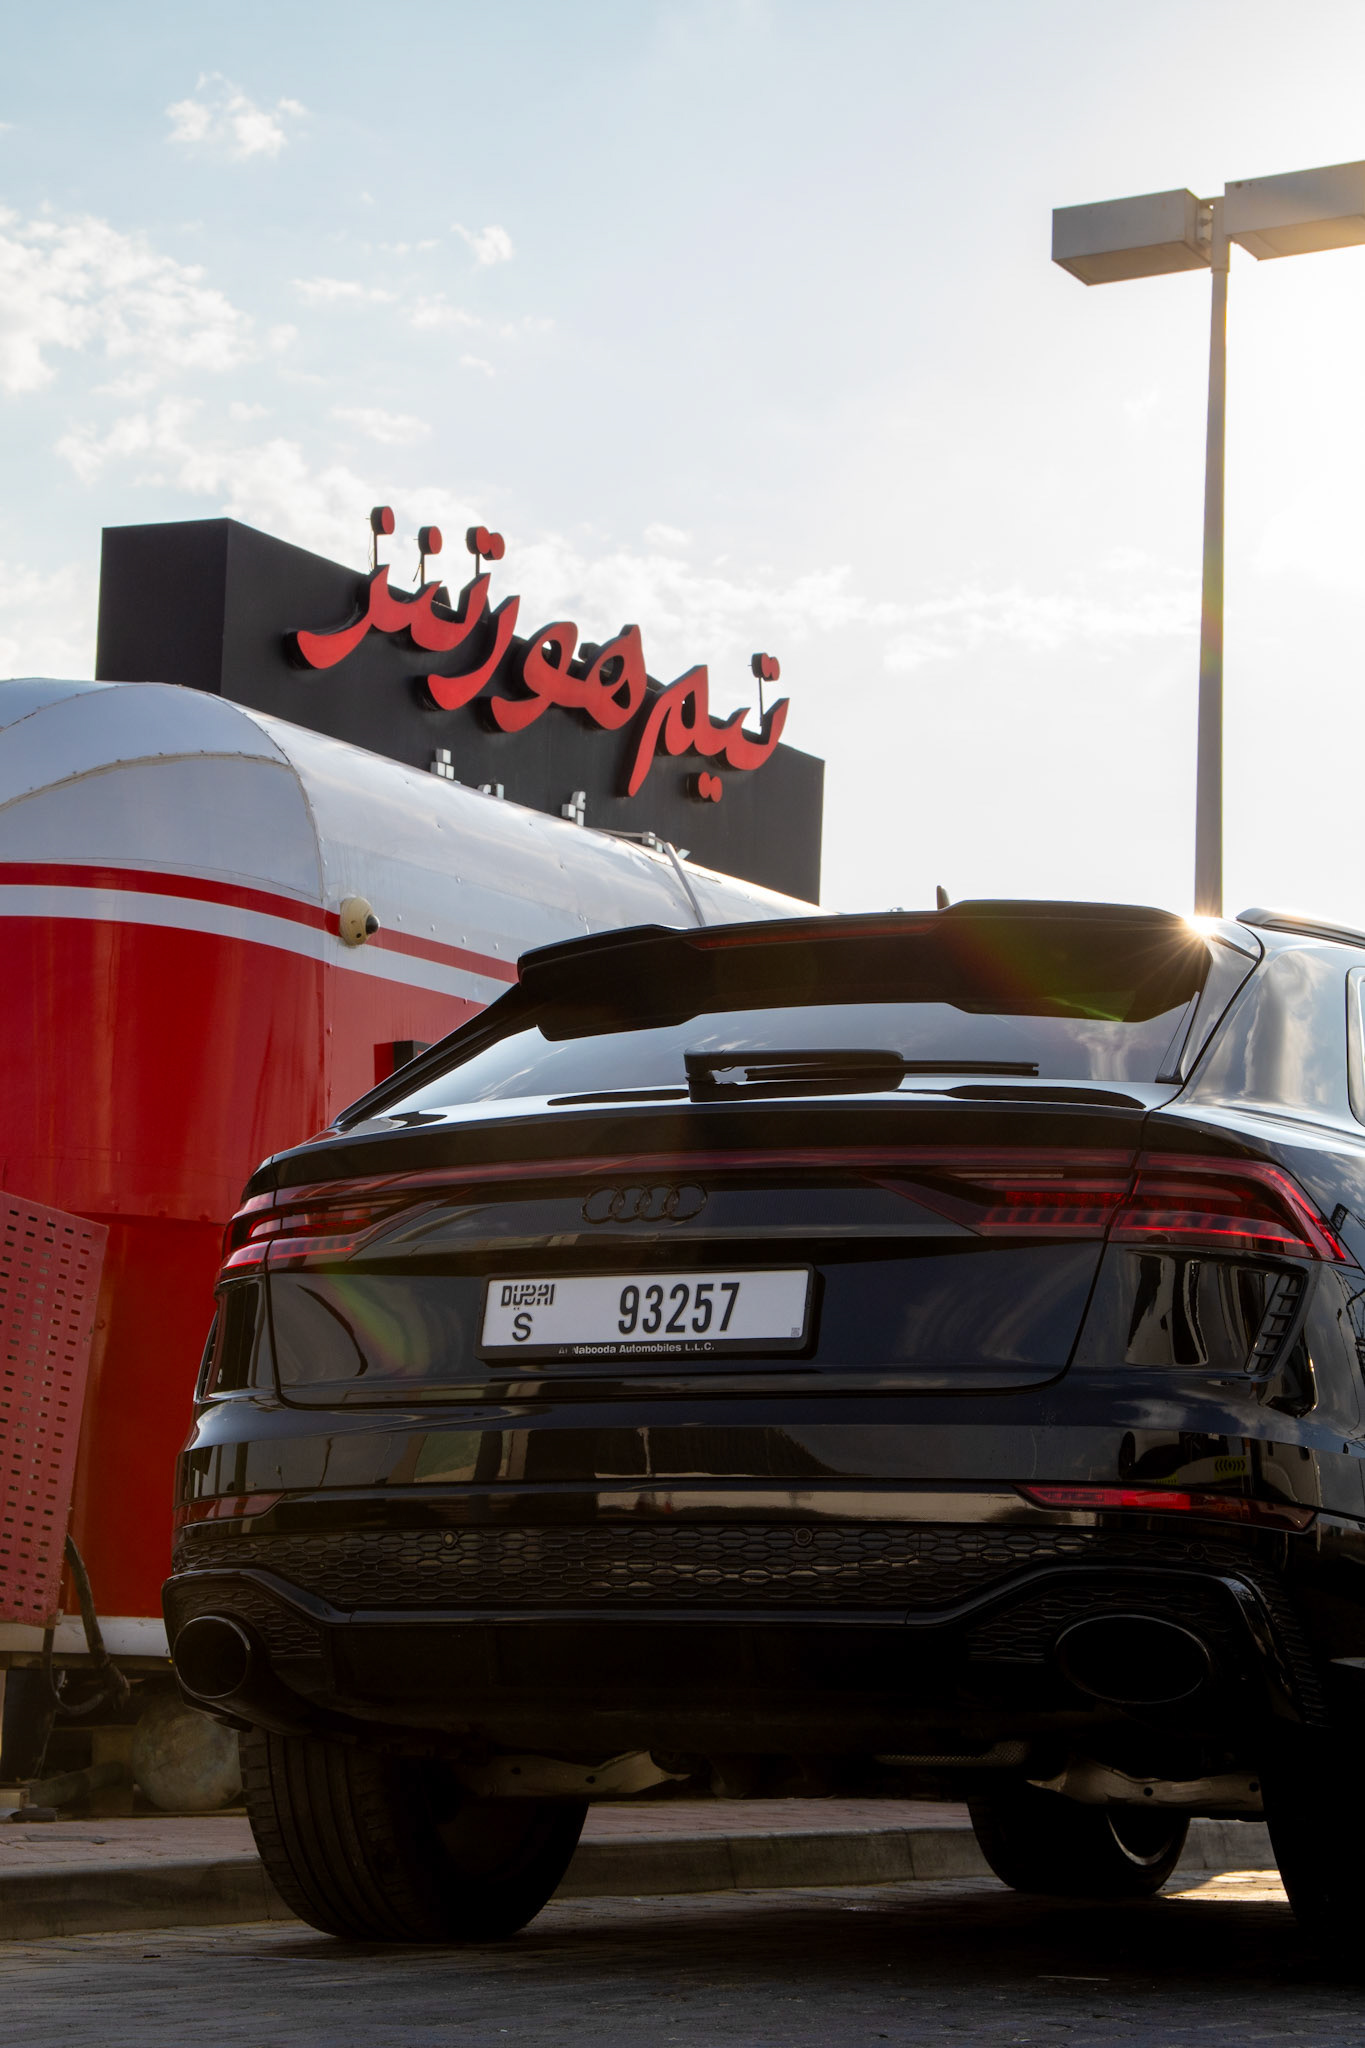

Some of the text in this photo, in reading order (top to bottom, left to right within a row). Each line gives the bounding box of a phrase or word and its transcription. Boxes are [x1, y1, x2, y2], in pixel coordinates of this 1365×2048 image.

[290, 505, 790, 803] تيم هورتنز
[512, 1312, 533, 1342] S
[618, 1282, 740, 1334] 93257
[619, 1343, 682, 1353] Automobiles
[685, 1342, 715, 1351] L.L.C.
